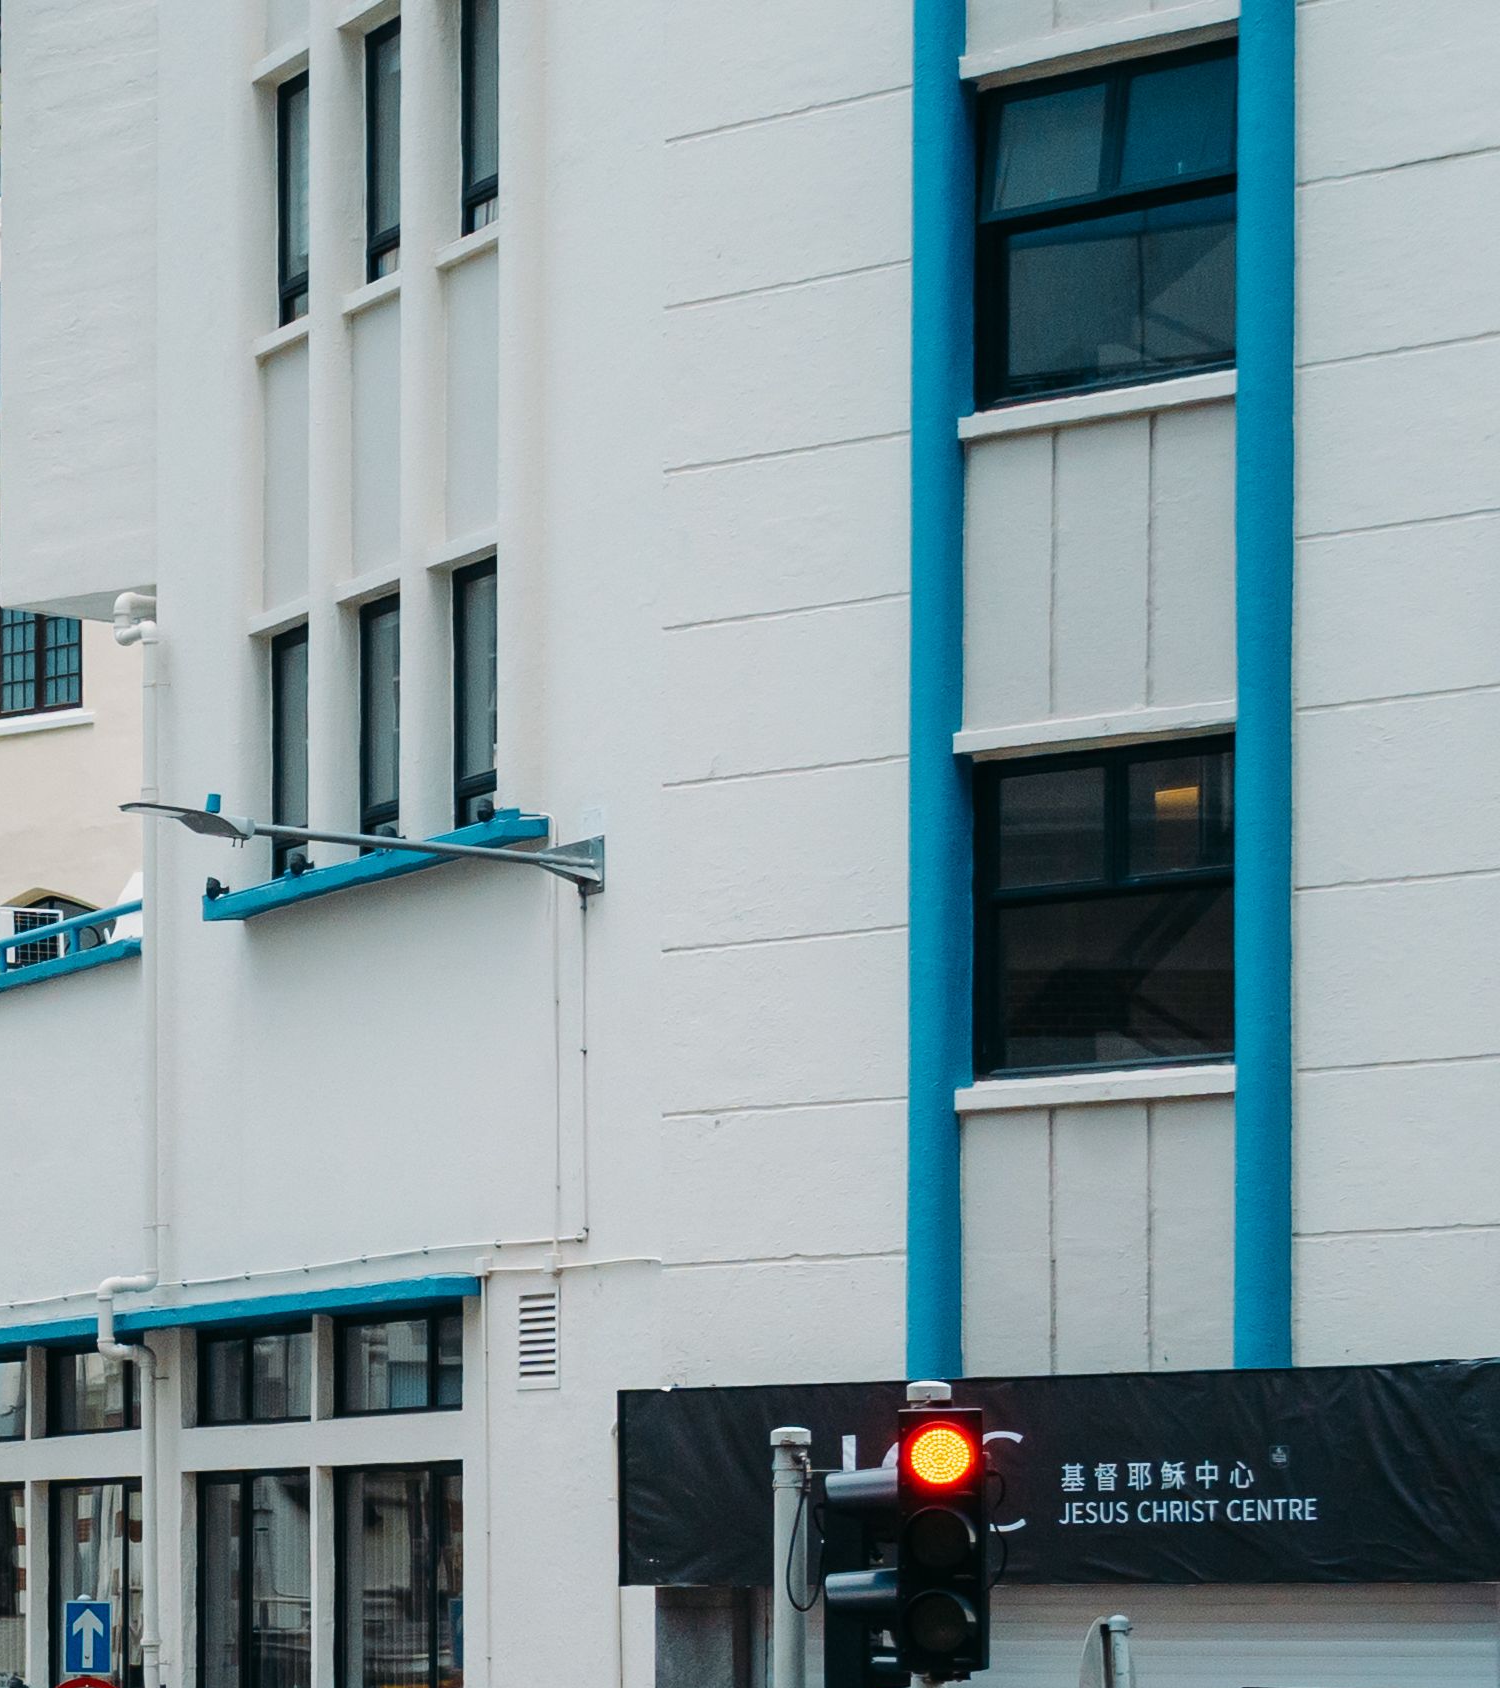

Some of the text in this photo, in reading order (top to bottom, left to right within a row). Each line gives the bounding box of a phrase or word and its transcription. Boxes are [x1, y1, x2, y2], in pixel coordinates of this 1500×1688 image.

[1061, 1461, 1255, 1492] 基督耶穌中心
[1059, 1498, 1318, 1525] JESUS CHRIST CENTRE
